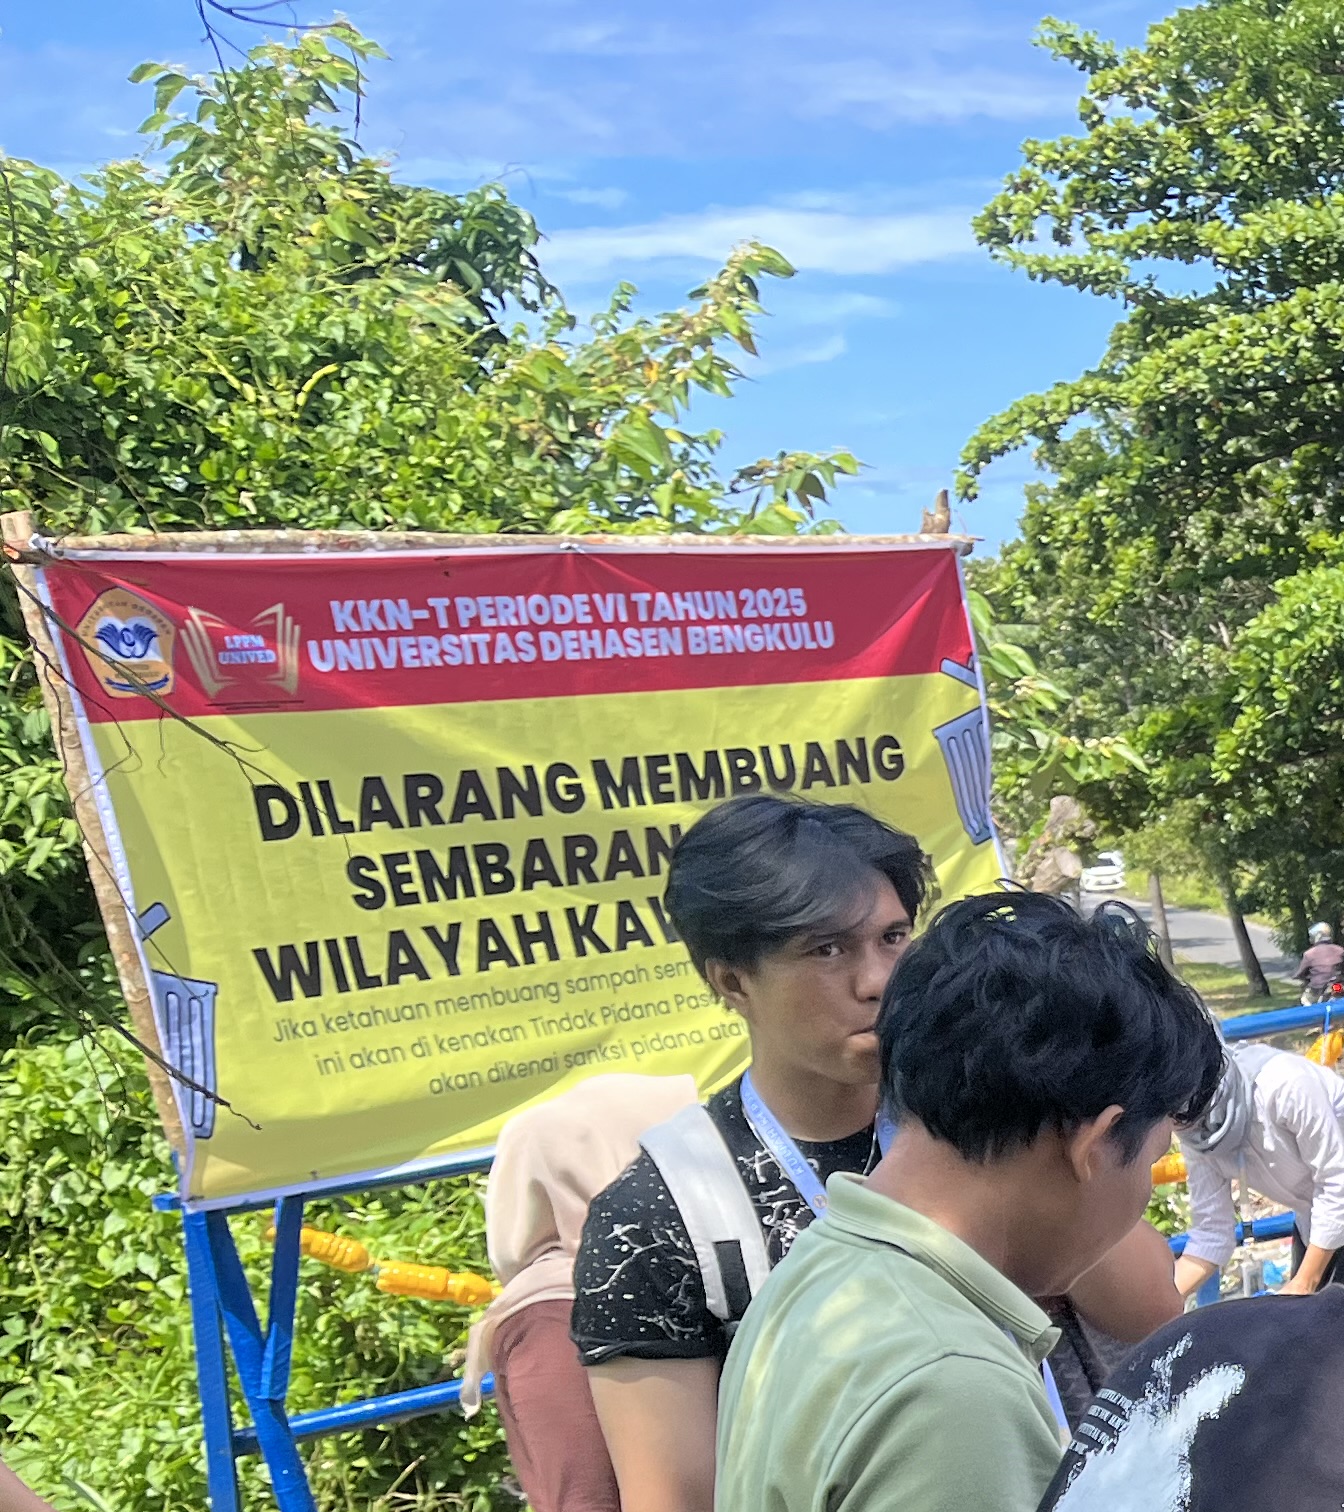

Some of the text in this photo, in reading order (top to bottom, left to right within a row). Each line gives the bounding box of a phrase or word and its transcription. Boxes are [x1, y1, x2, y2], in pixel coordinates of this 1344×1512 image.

[307, 621, 835, 672] UNIVERSITAS DEHASEN BENGKULU
[329, 588, 808, 632] KKN-T PERIODE VI TAHUN 2025
[252, 734, 905, 841] DILARANG MEMBUANG
[346, 824, 681, 910] SEMBARAN
[252, 911, 560, 1001] WILAYAH
[273, 960, 693, 1043] Jika ketahuan membuang sampah sem
[315, 994, 716, 1076] ini akan di kenakan Tindak Pidana Pas
[429, 1072, 484, 1095] akan
[487, 1051, 559, 1085] dikenai
[564, 1038, 627, 1070] sanksi
[630, 1028, 704, 1062] pidana
